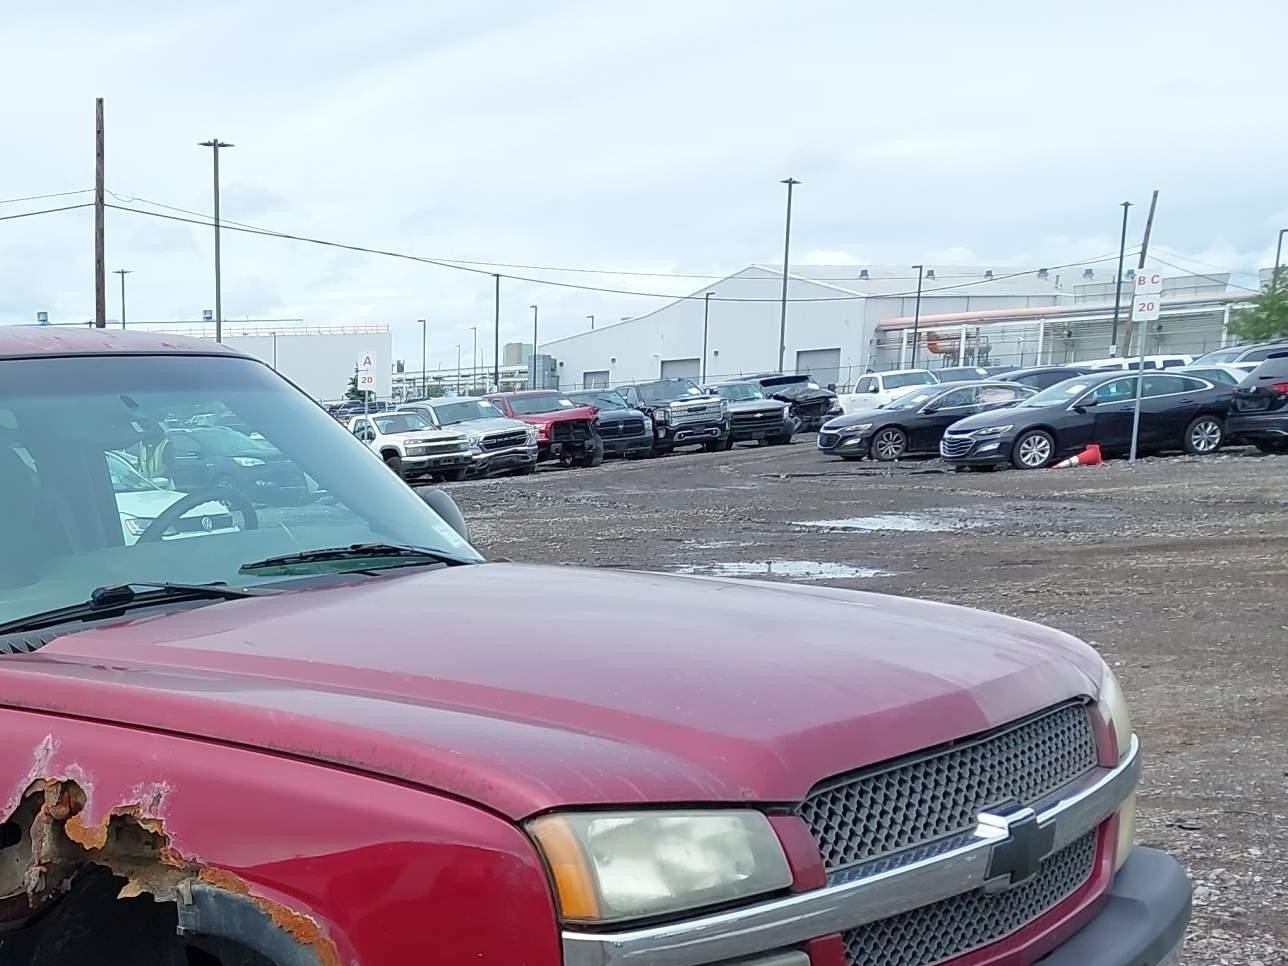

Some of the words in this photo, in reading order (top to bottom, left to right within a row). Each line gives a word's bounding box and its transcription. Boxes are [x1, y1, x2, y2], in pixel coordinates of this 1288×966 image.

[1138, 276, 1146, 286] B
[1151, 274, 1160, 284] C
[1138, 302, 1154, 312] 20
[363, 356, 372, 366] A
